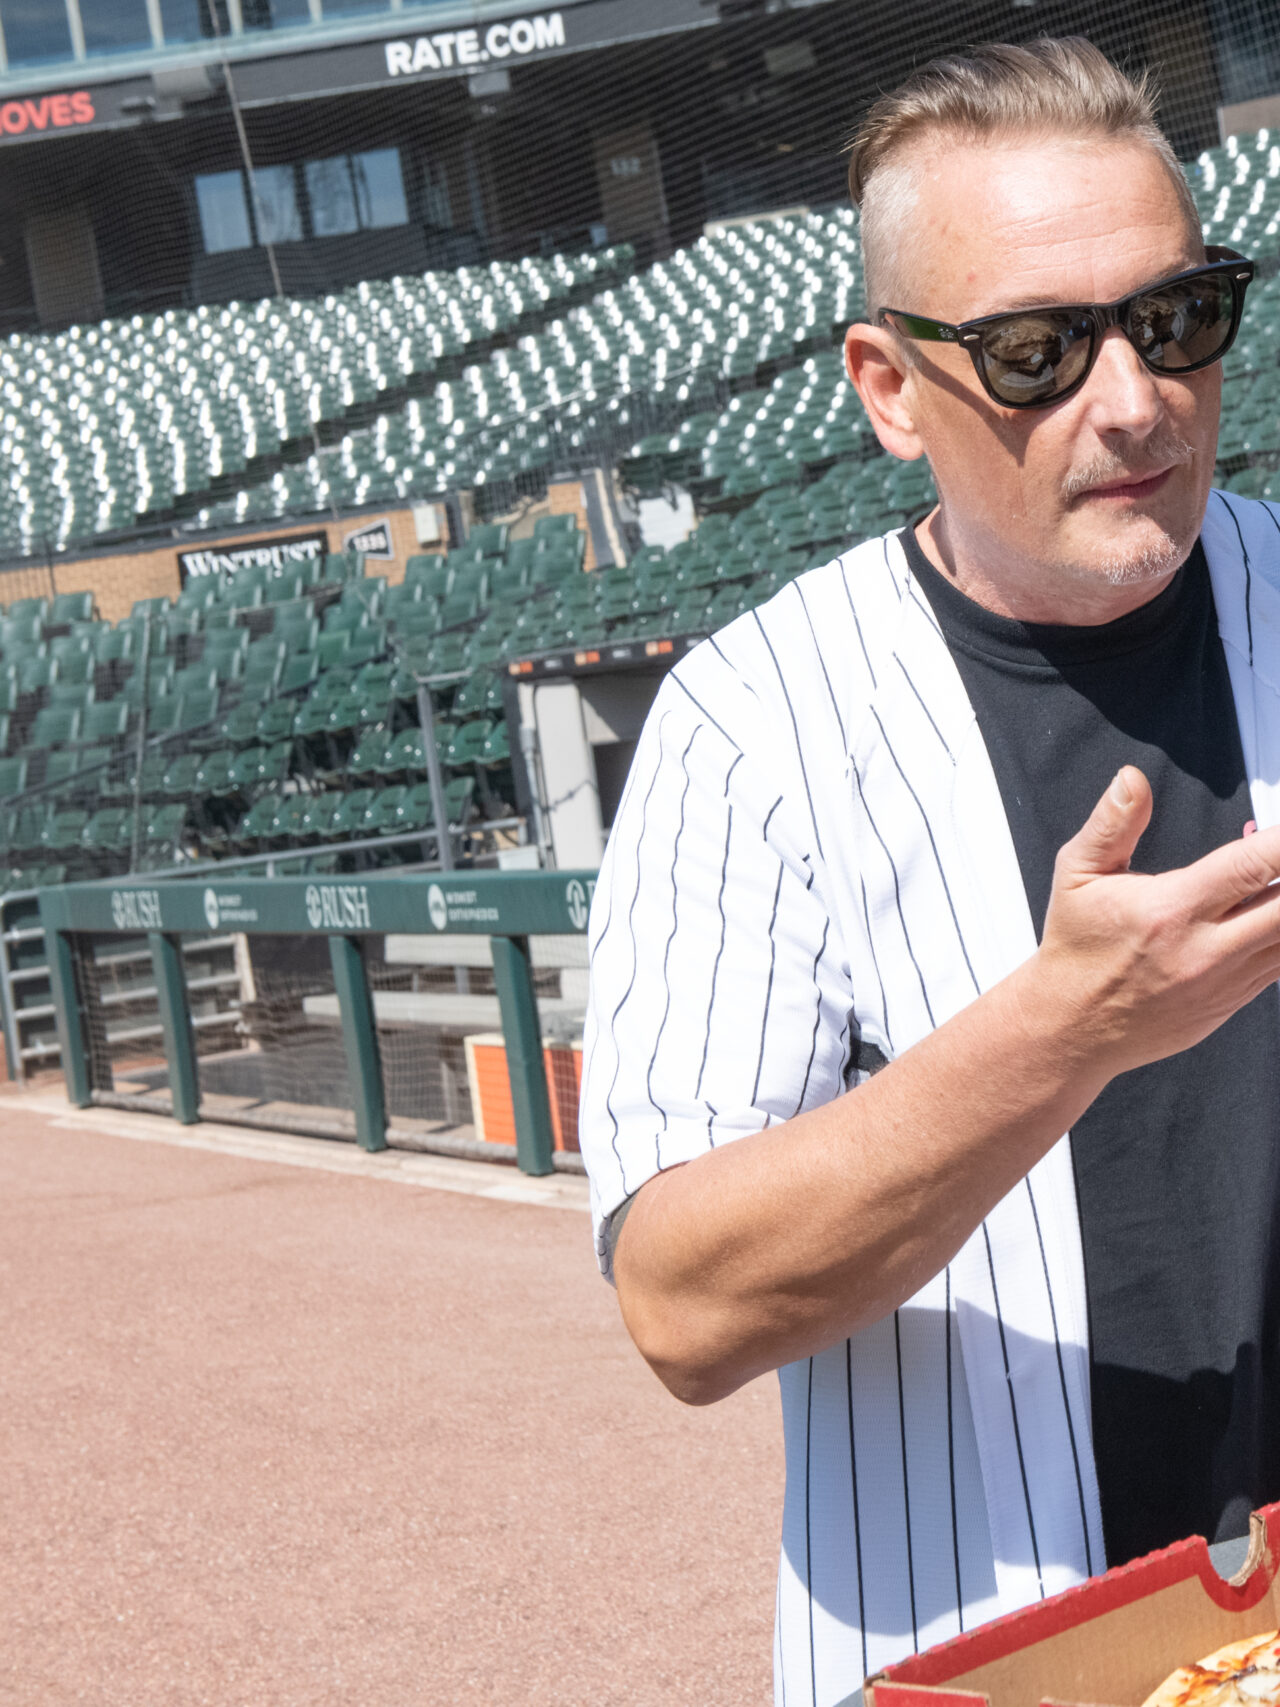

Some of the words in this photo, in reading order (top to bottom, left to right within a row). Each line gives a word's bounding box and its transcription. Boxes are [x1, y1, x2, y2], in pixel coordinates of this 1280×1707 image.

[385, 12, 565, 76] RATE.COM
[0, 91, 95, 136] OVES
[121, 890, 163, 929] RUSH
[320, 886, 371, 929] RUSH
